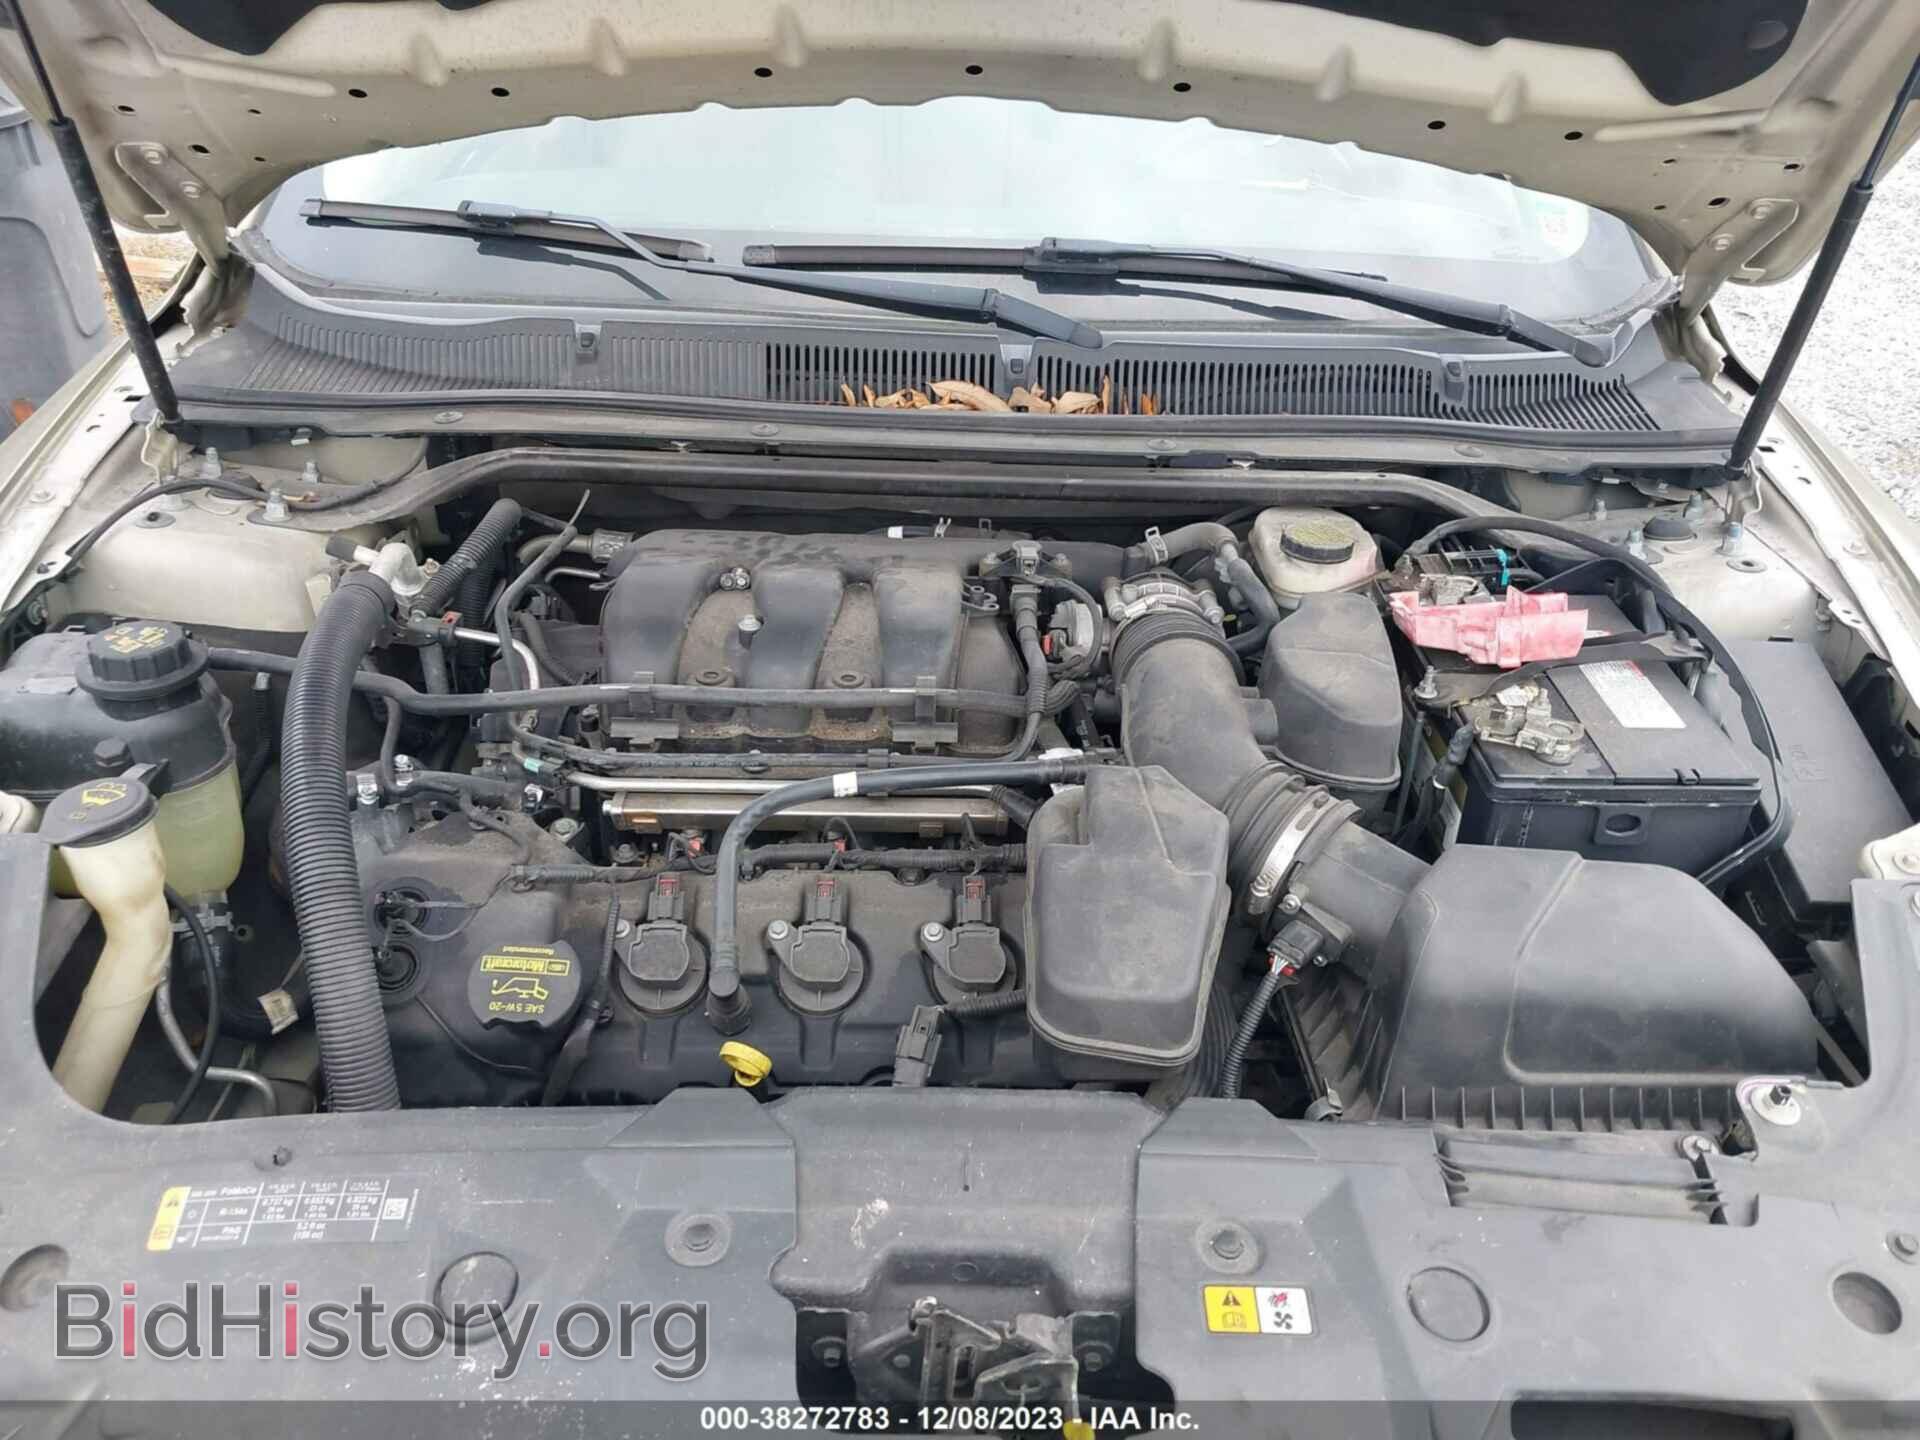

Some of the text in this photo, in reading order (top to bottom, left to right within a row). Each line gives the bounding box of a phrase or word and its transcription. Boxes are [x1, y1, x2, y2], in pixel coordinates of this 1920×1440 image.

[486, 958, 545, 972] Motorcraft
[489, 1001, 545, 1014] SAE 5W-20
